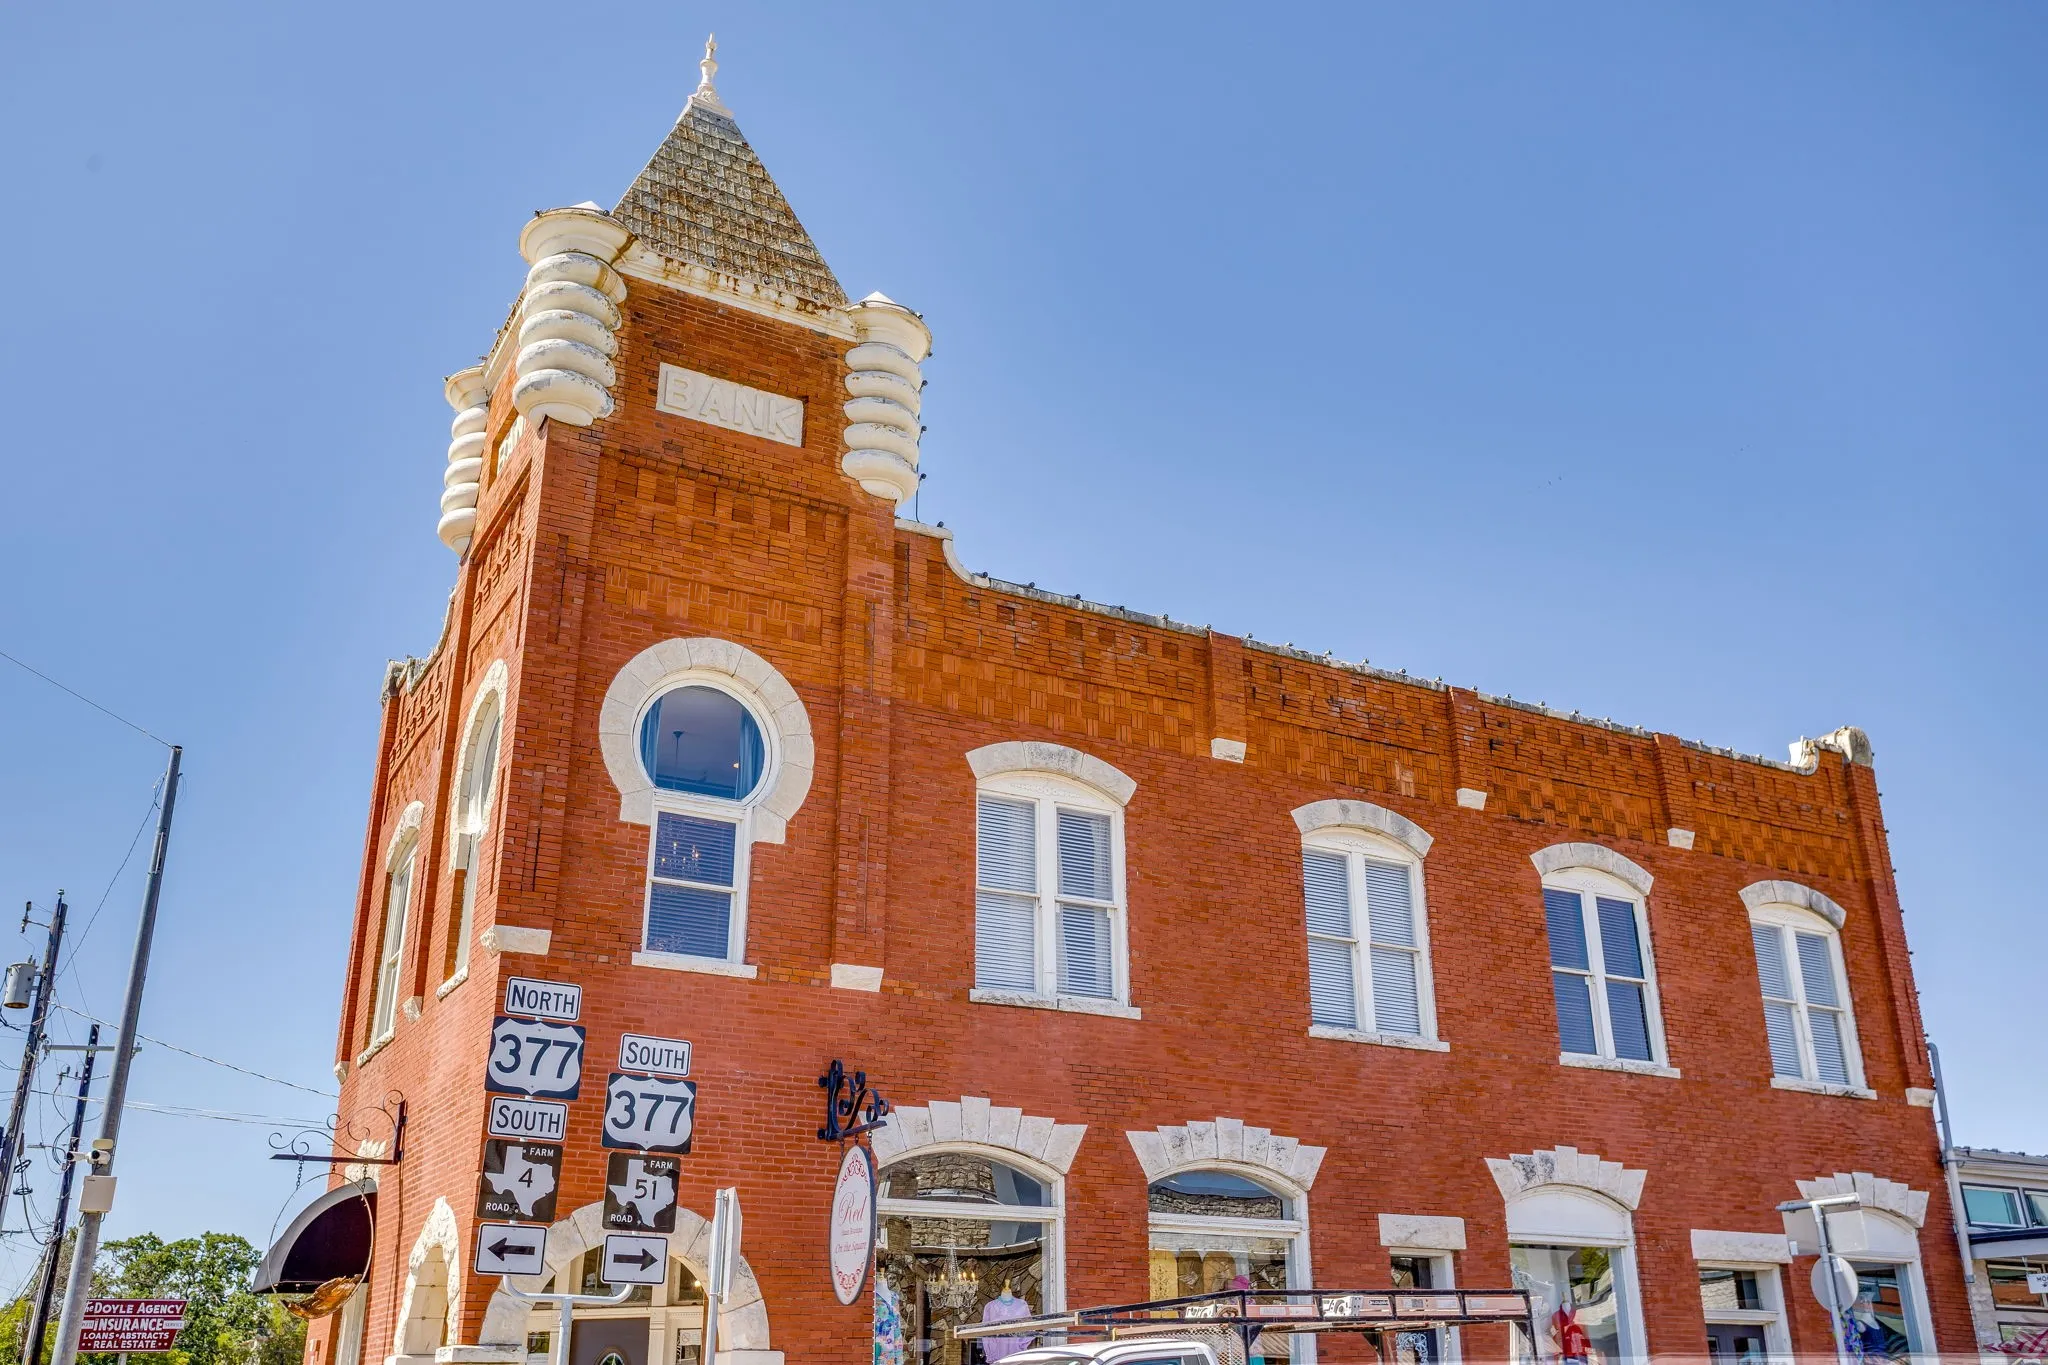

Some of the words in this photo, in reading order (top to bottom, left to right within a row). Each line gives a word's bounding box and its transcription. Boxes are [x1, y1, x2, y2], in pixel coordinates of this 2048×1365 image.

[664, 371, 799, 440] BANK
[511, 984, 575, 1014] NORTH
[495, 1034, 578, 1079] 377
[626, 1041, 685, 1070] SOUTH
[496, 1105, 561, 1134] SOUTH
[611, 1090, 689, 1134] 377
[530, 1147, 554, 1157] FARM
[650, 1160, 673, 1170] FARM
[518, 1168, 533, 1188] 4
[634, 1180, 658, 1200] 51
[486, 1202, 510, 1213] ROAD
[611, 1213, 633, 1224] ROAD
[94, 1302, 133, 1314] DOYLE
[137, 1302, 183, 1314] AGENCY
[83, 1332, 114, 1340] LOANS
[119, 1332, 169, 1340] ABSTRACTS
[93, 1341, 119, 1349] REAL
[121, 1341, 156, 1349] ESTATE
